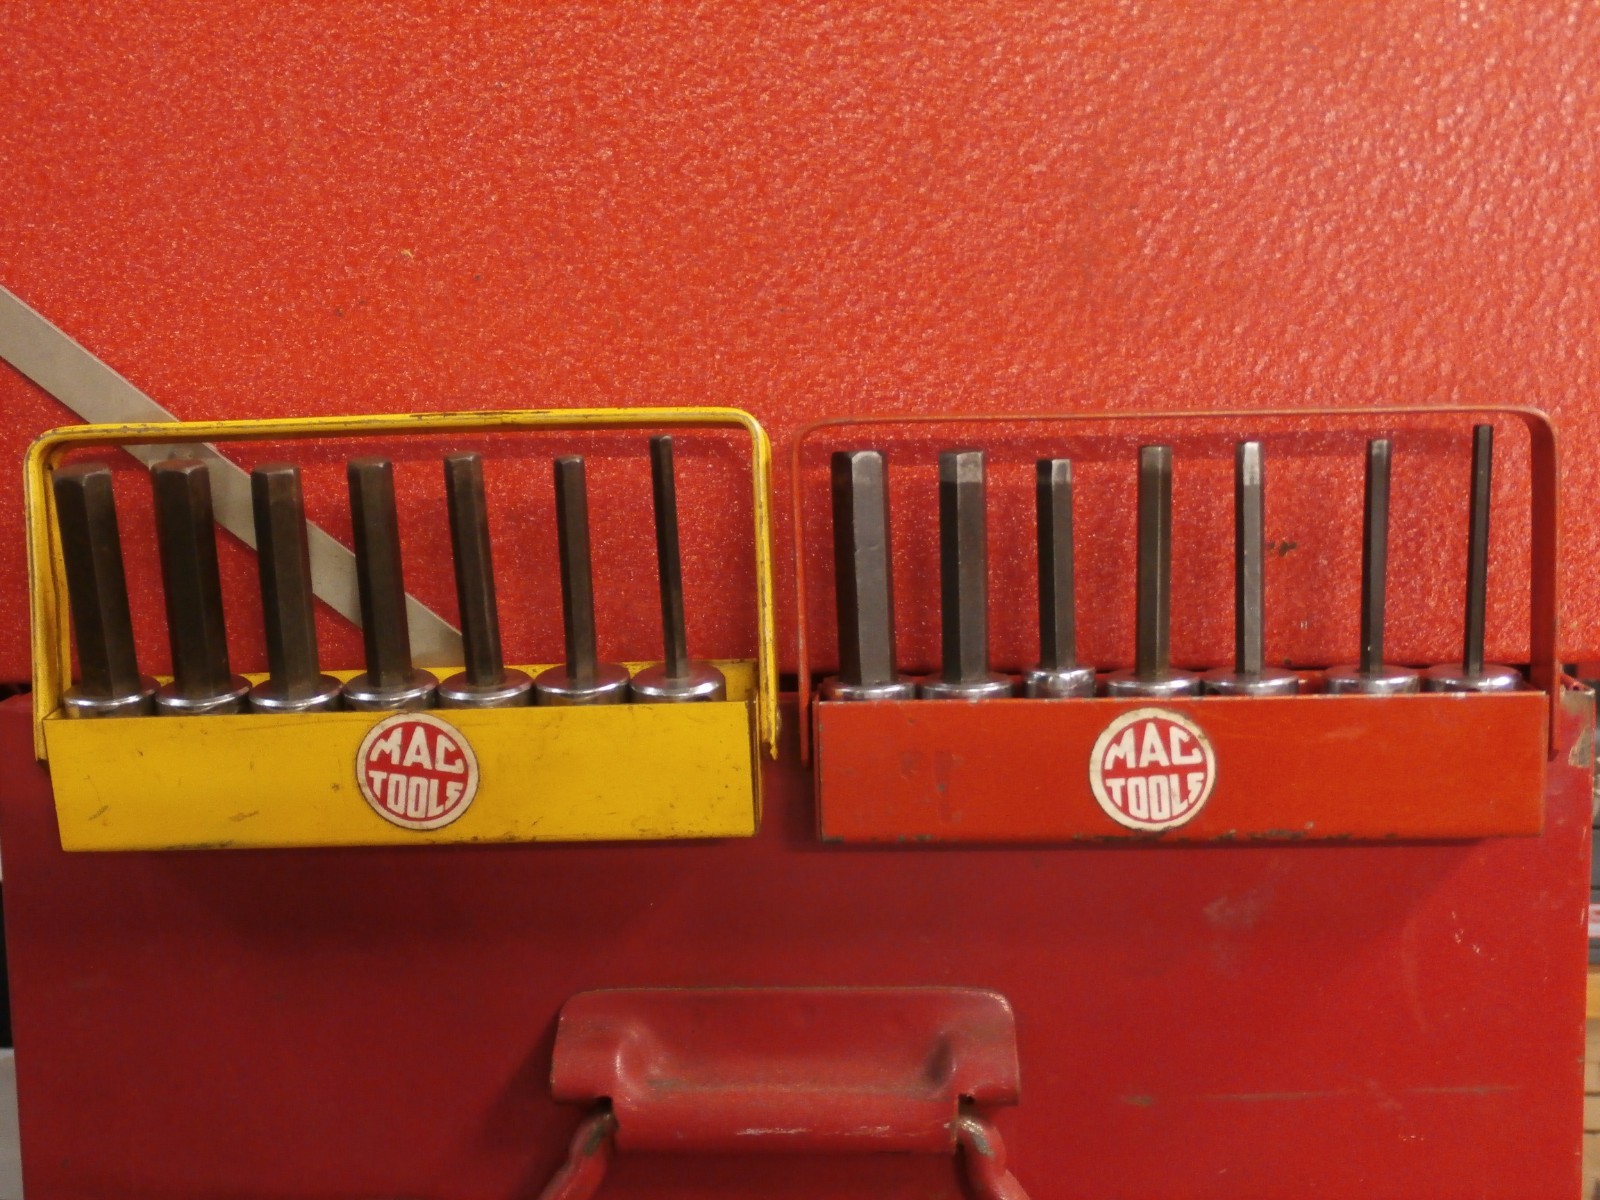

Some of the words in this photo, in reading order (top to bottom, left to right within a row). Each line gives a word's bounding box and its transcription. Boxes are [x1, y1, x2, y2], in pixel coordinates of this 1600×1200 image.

[369, 725, 465, 774] MAC
[1104, 722, 1203, 770] MAC
[368, 770, 464, 818] TOOLS
[1105, 772, 1204, 820] TOOLS
